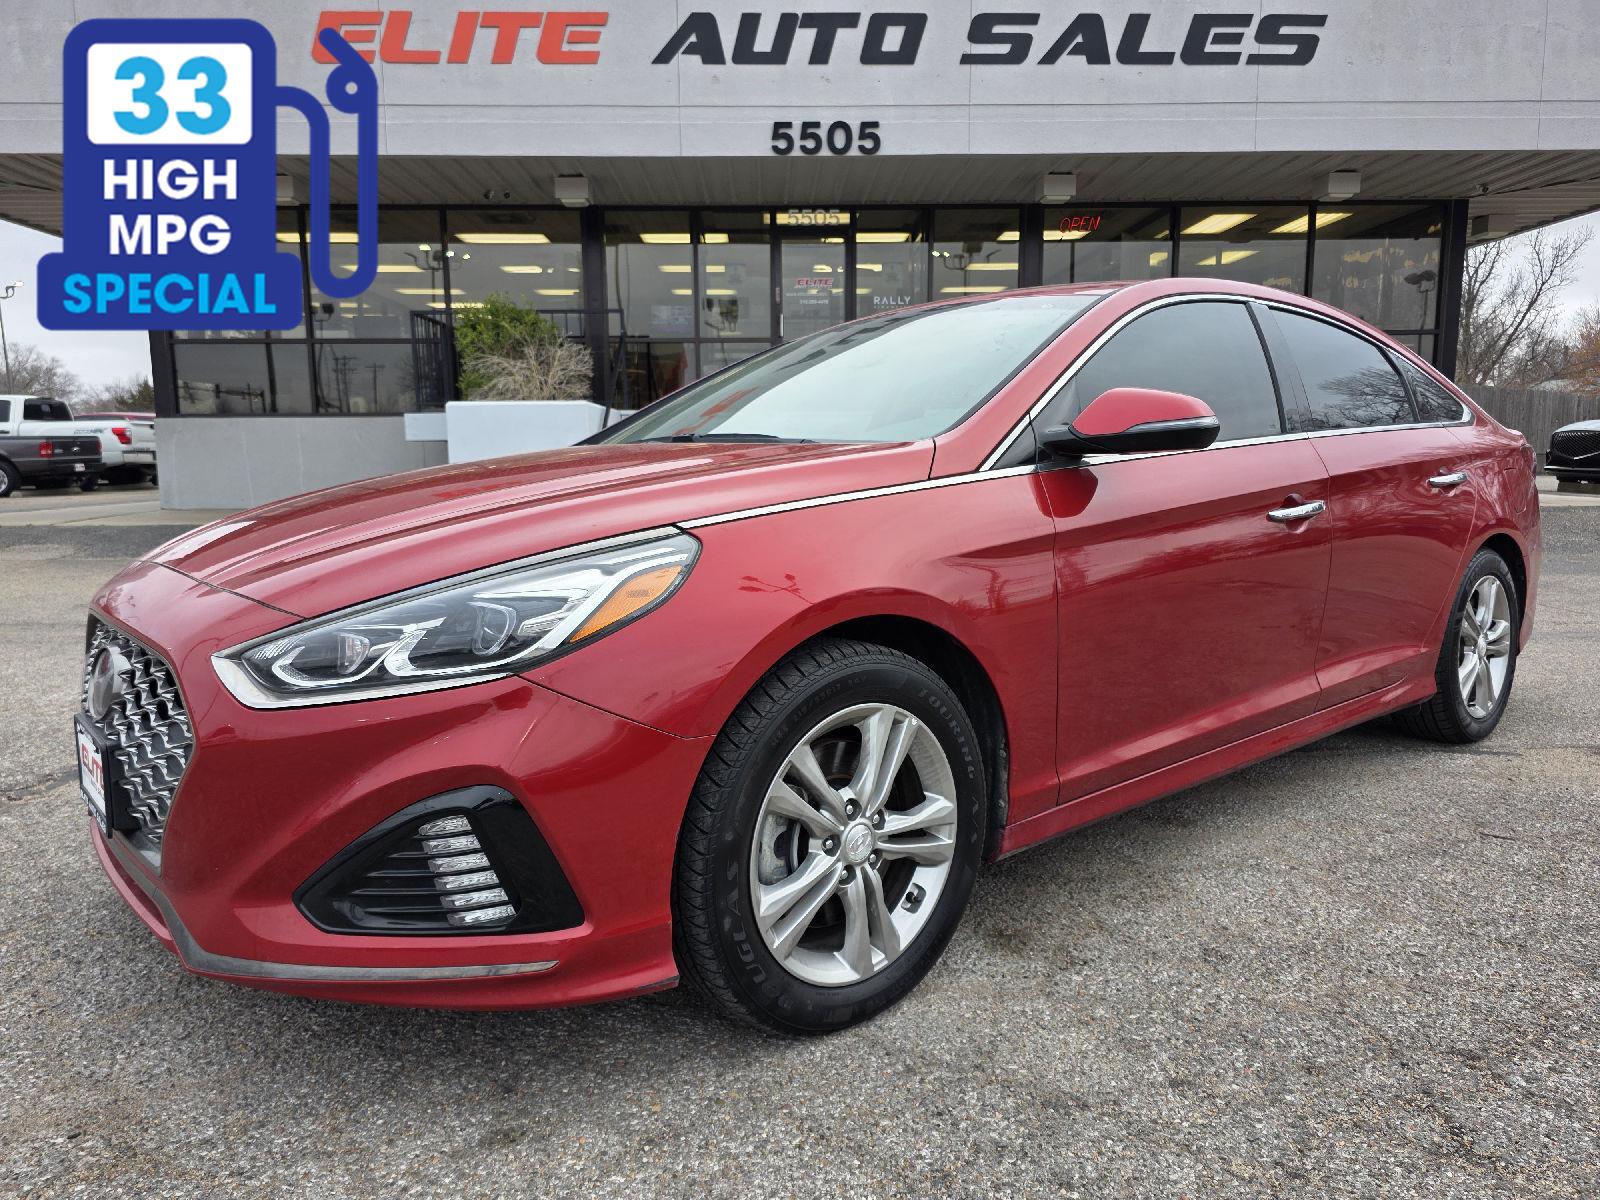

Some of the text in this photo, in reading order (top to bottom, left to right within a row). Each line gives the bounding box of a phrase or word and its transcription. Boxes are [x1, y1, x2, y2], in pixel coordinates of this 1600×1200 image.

[311, 11, 1328, 65] ELITE AUTO SALES
[771, 121, 882, 156] 5505
[788, 209, 840, 226] 5505
[1060, 216, 1101, 233] OPEN
[796, 278, 833, 286] ELITE
[873, 296, 911, 305] RALLY
